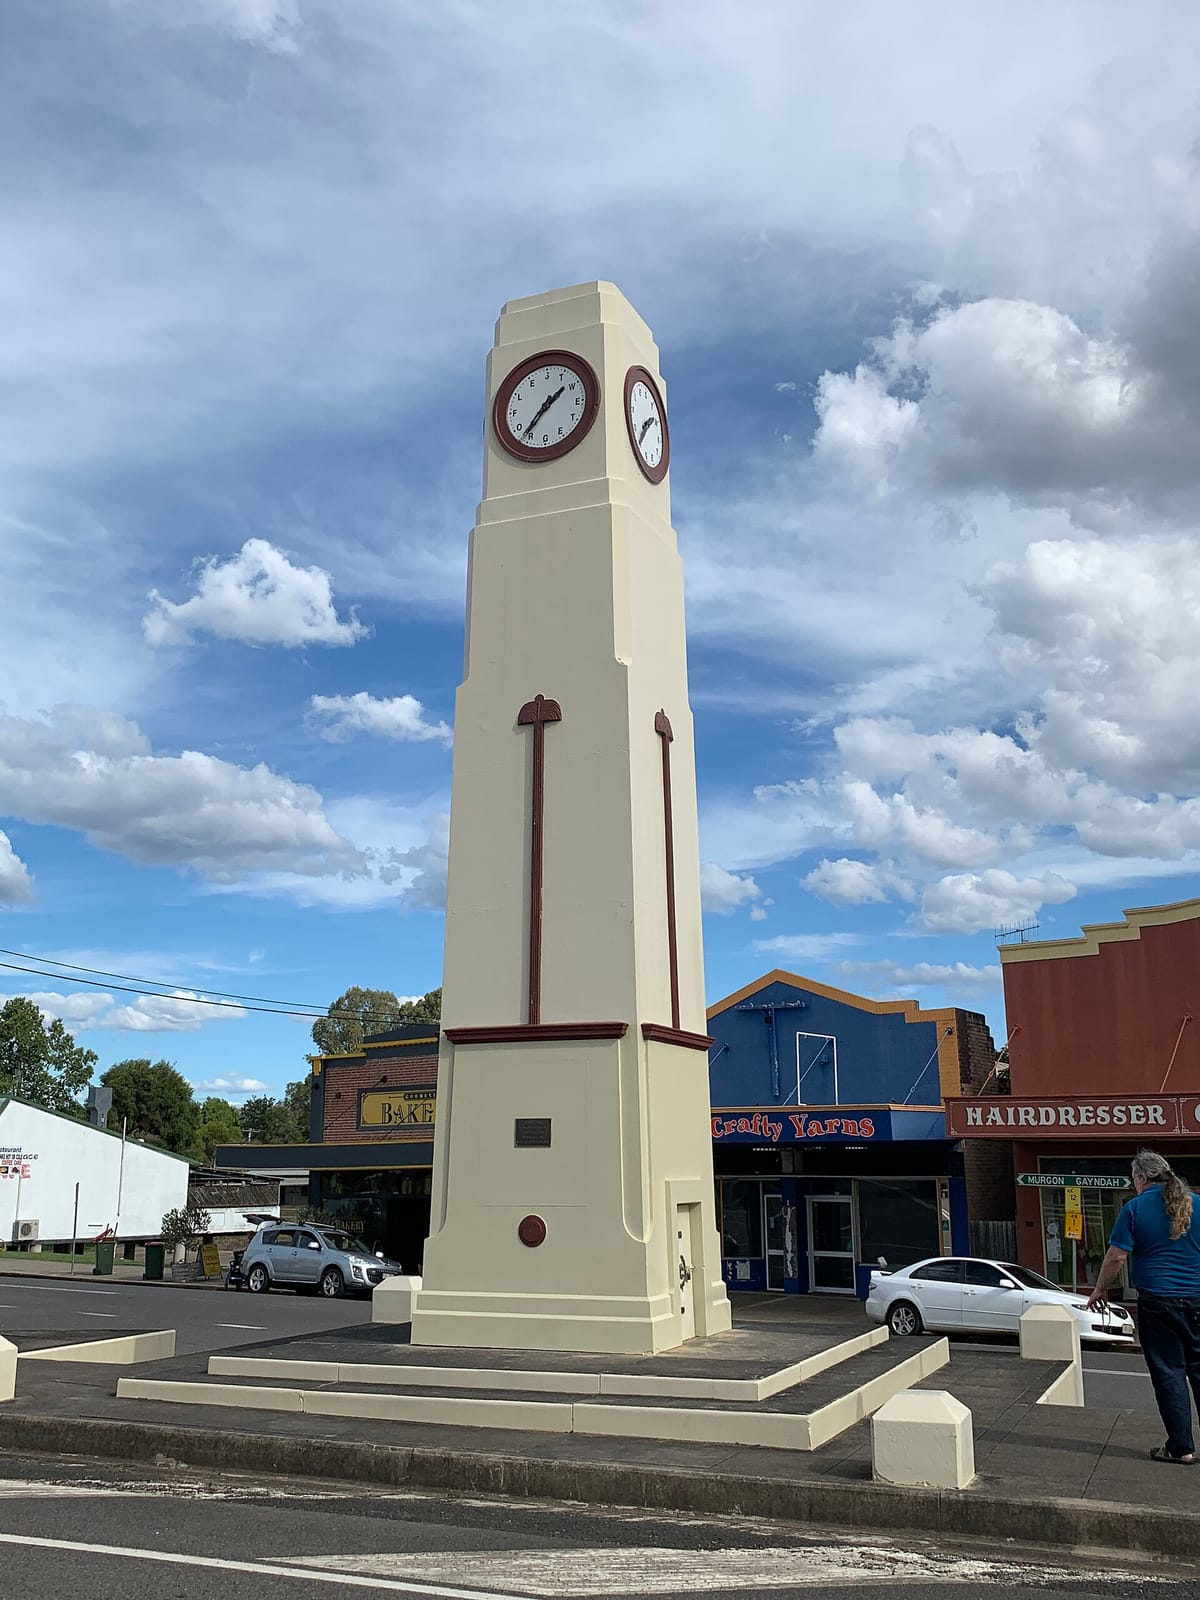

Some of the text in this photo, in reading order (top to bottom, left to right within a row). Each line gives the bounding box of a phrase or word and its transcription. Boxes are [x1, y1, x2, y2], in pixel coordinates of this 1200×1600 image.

[381, 1103, 433, 1124] BAKE
[966, 1105, 1167, 1126] HAIRDRESSER
[711, 1113, 875, 1142] Crafty Yarns
[1028, 1176, 1120, 1187] MURGON GAYNDAH
